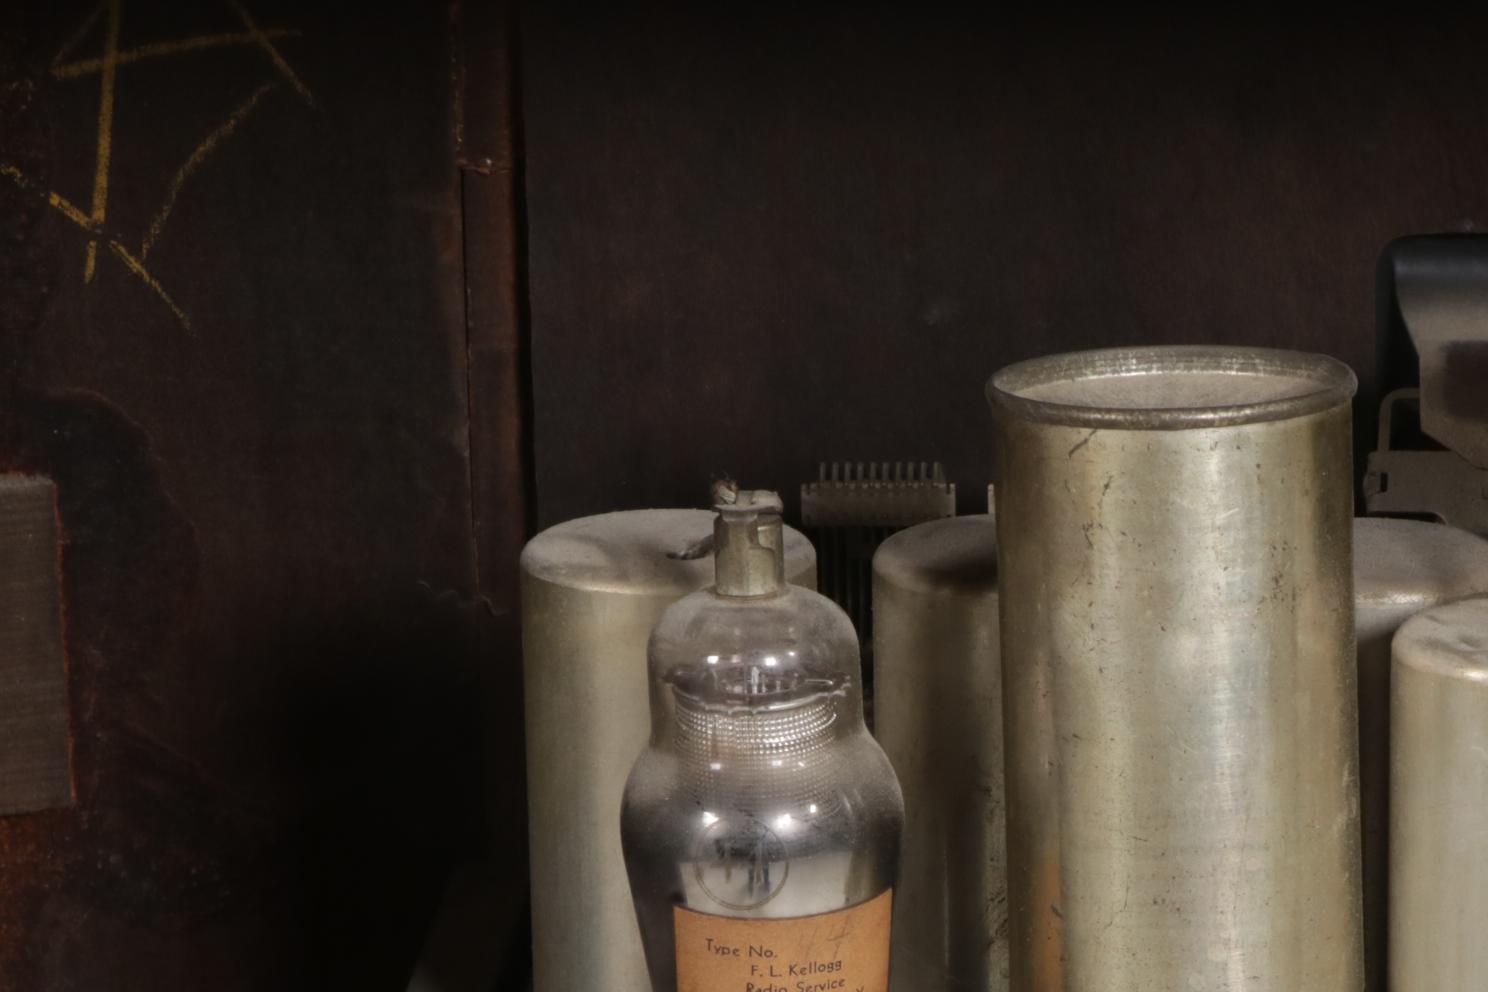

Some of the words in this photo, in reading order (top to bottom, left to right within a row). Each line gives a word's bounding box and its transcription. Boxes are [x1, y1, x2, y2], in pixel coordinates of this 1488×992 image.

[705, 938, 741, 957] Type
[748, 944, 778, 959] No.
[750, 965, 763, 977] F.
[770, 964, 783, 977] L.
[788, 958, 843, 976] Kellogg
